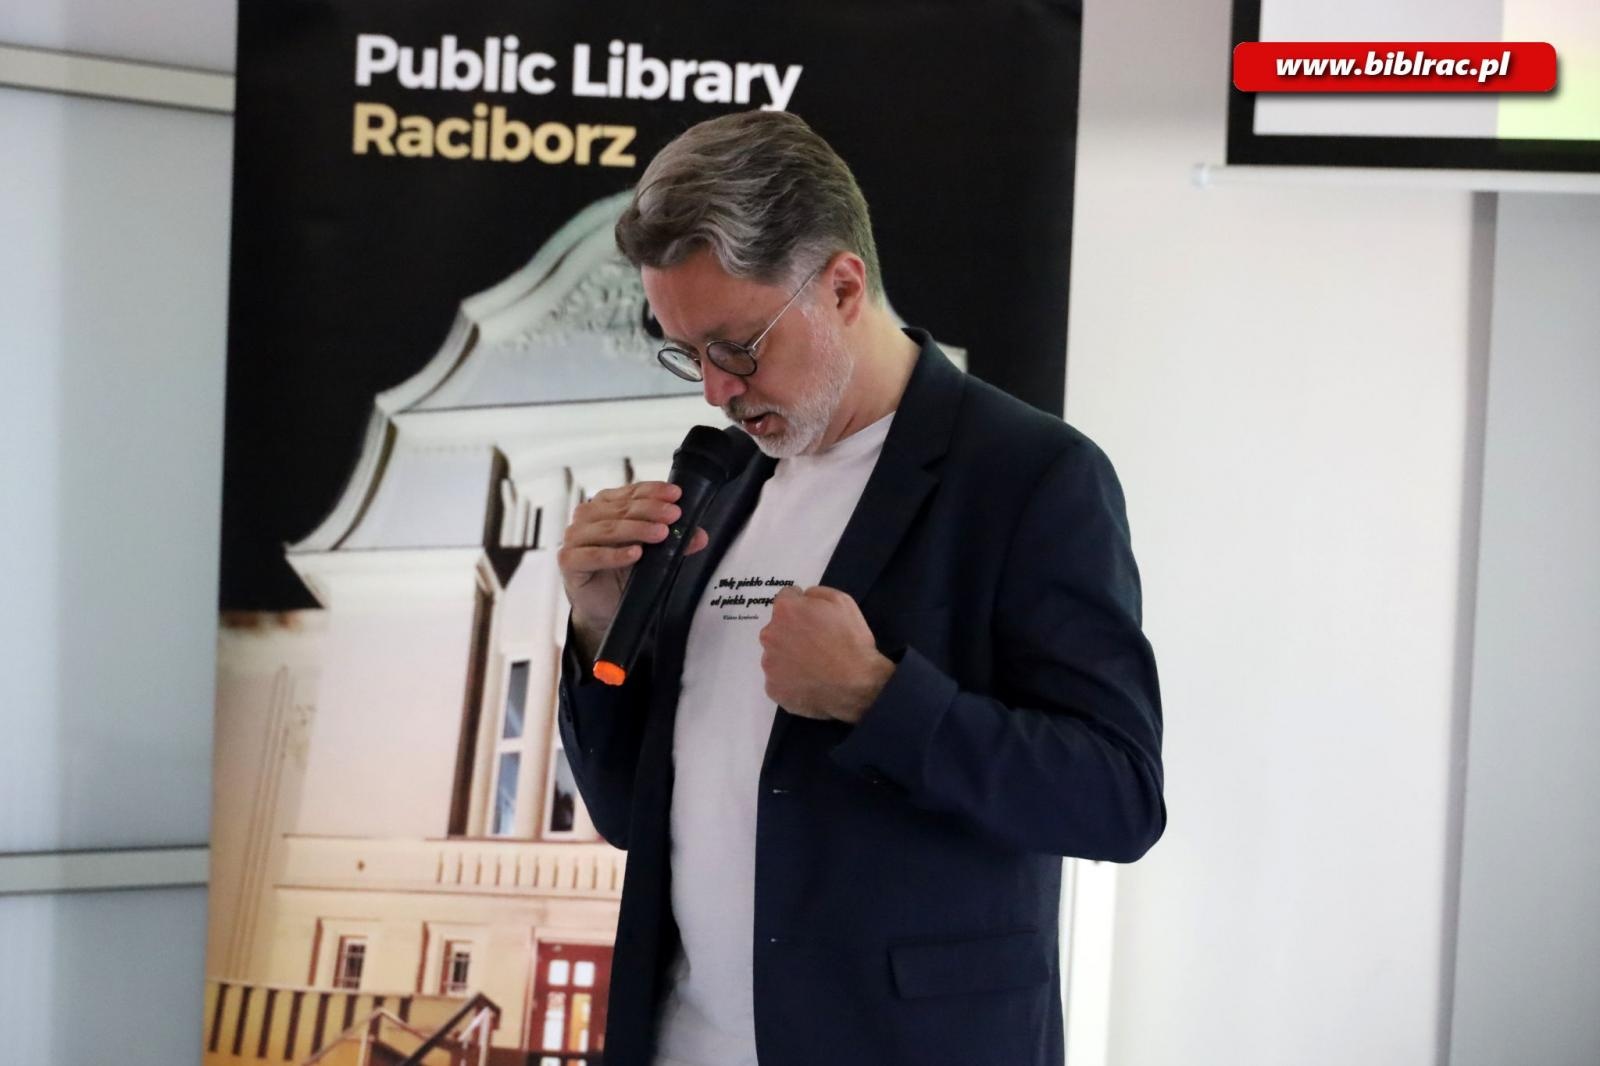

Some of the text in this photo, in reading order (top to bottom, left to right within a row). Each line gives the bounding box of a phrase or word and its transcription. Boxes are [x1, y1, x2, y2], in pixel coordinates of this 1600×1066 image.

[355, 34, 803, 112] Public Library
[352, 103, 636, 167] Raciborz
[710, 595, 721, 606] od
